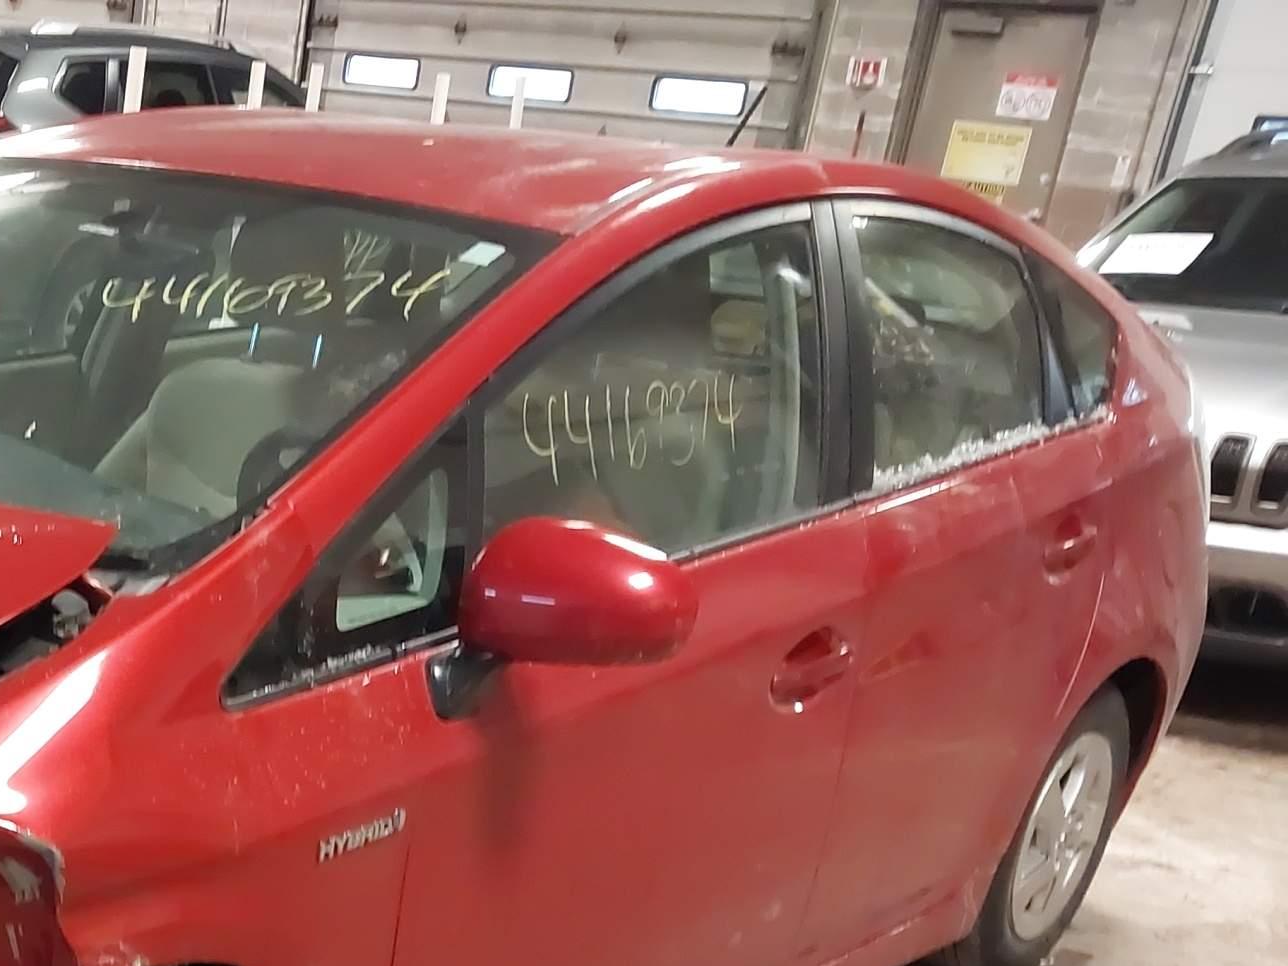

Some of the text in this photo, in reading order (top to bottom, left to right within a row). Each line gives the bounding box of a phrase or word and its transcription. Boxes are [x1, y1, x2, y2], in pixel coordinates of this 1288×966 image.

[101, 268, 451, 323] 44169374
[522, 370, 743, 487] 44169374
[318, 814, 394, 864] HYBRID
